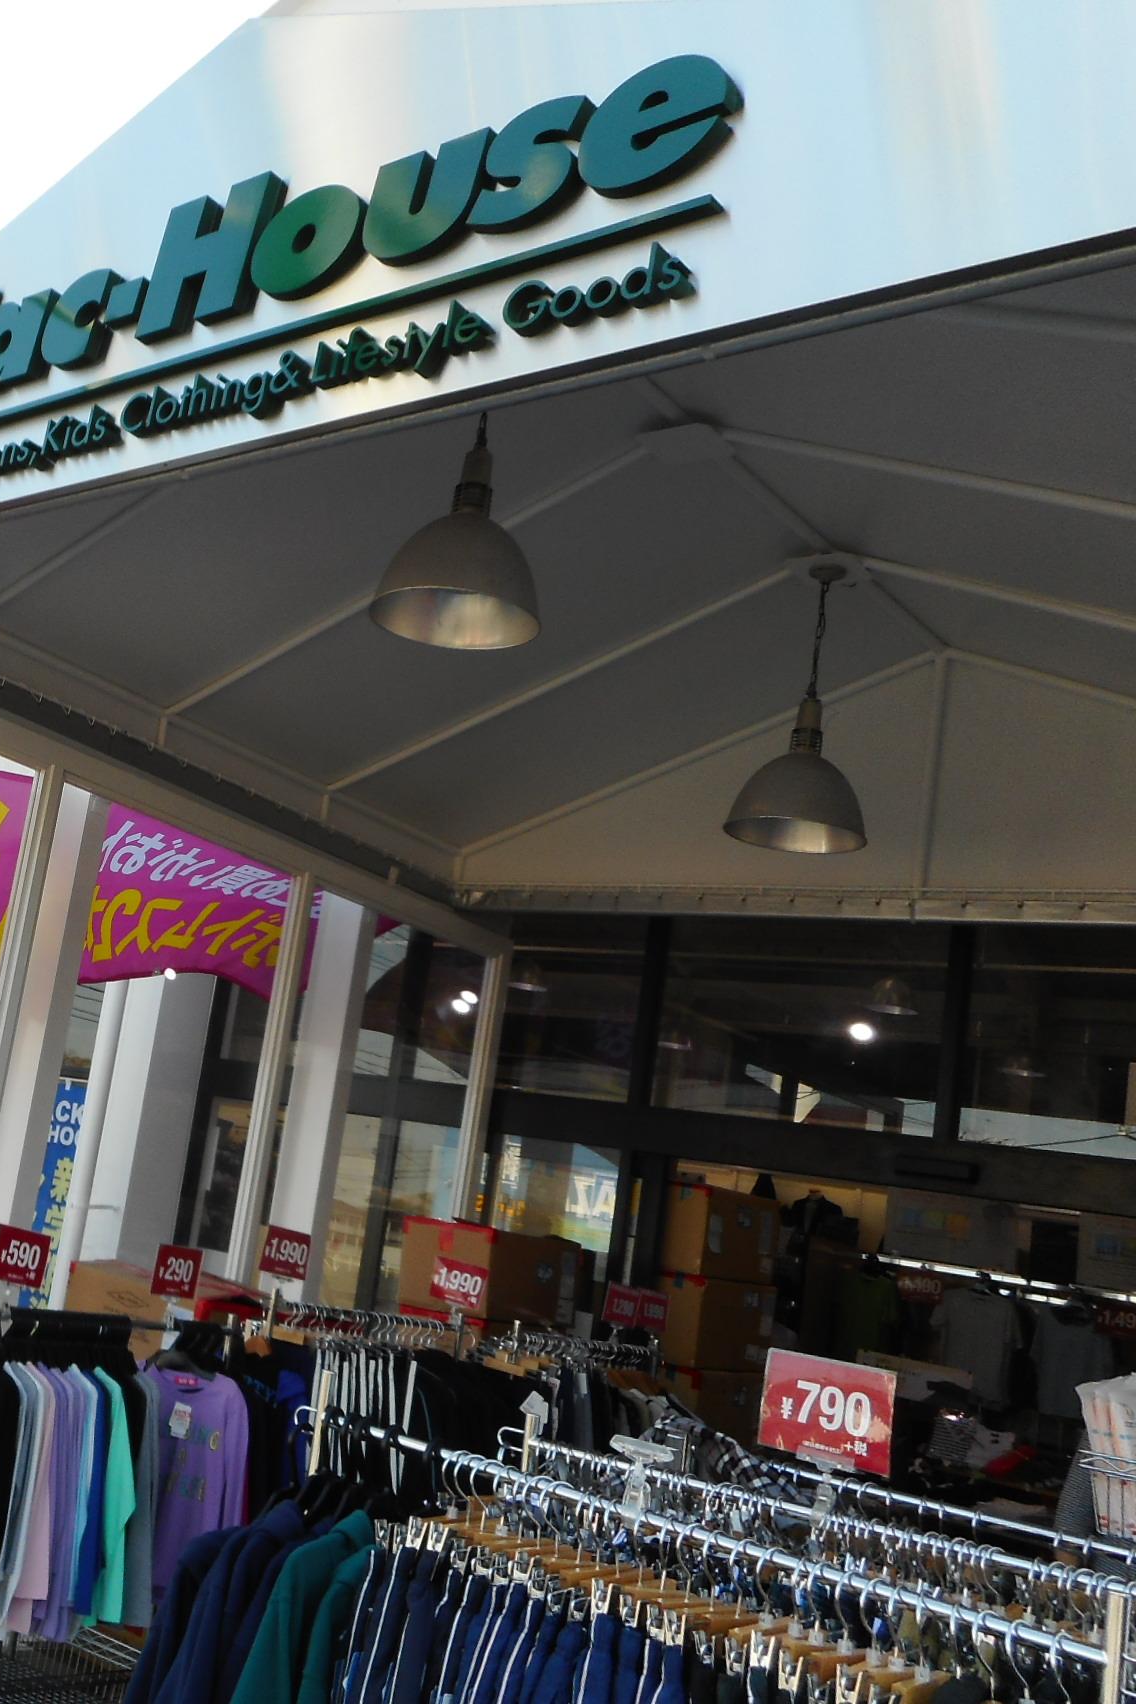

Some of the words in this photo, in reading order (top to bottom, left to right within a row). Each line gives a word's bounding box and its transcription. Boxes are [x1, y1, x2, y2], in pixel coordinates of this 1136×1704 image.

[502, 241, 697, 337] Goods
[0, 1239, 41, 1270] ¥590
[159, 1256, 194, 1283] ¥290
[780, 1379, 872, 1438] ¥790
